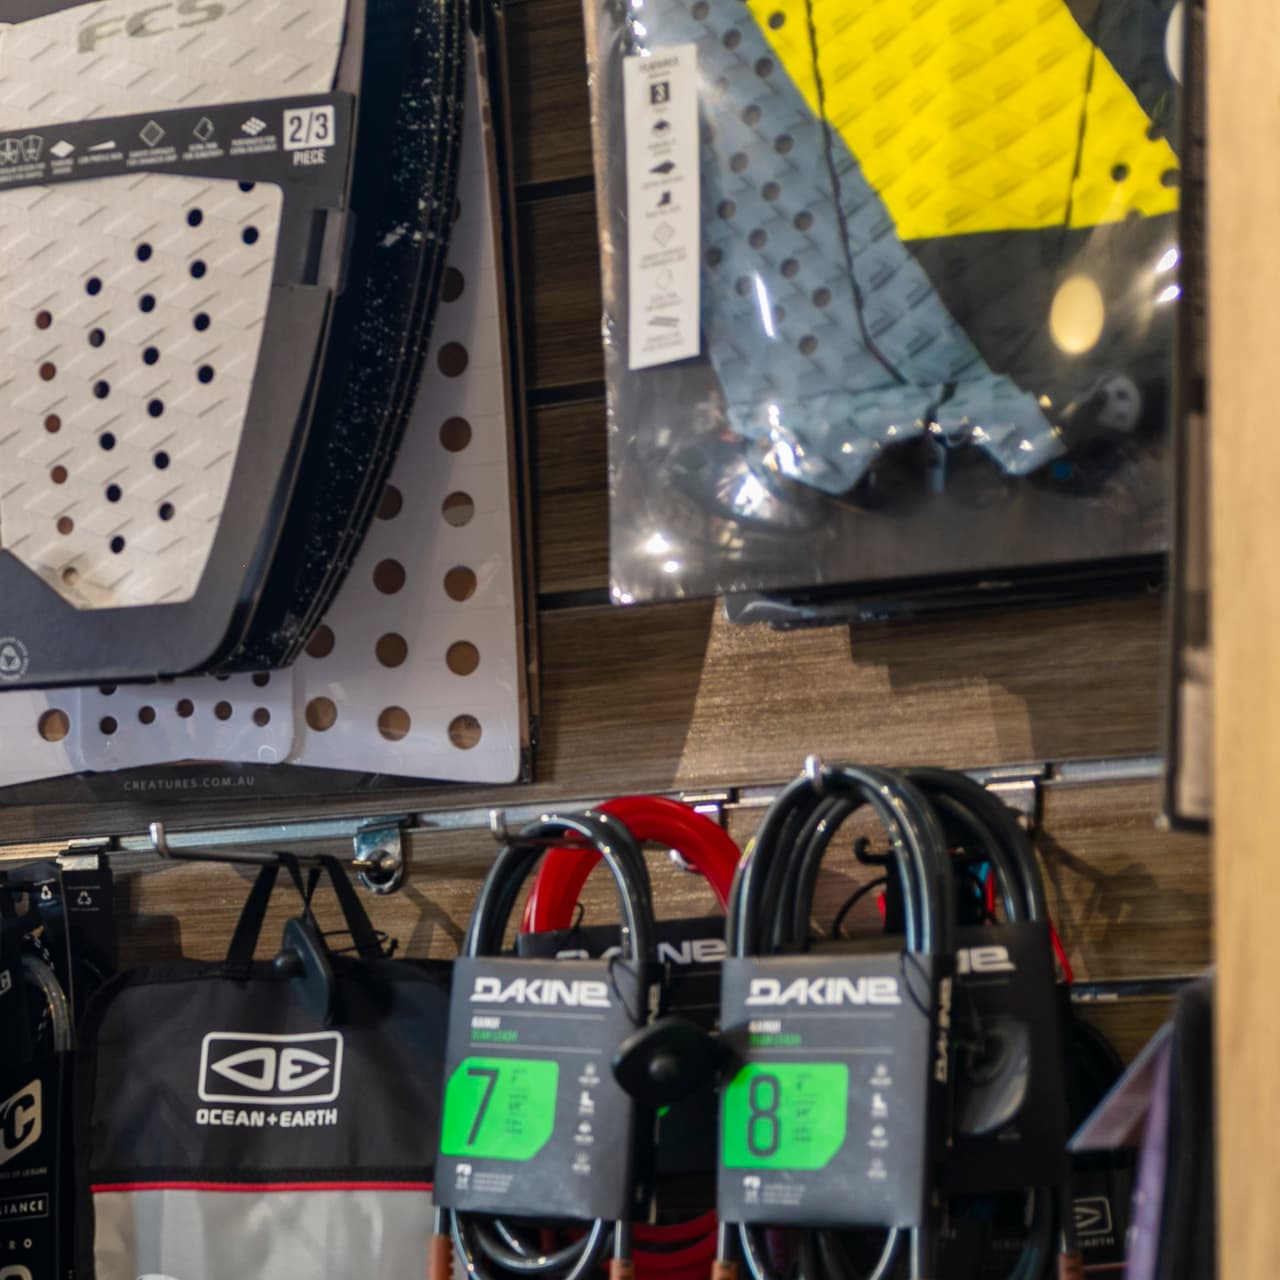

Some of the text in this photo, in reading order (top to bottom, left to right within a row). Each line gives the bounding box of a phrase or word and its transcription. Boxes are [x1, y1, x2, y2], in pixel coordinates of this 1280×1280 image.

[77, 0, 225, 54] FCS
[289, 111, 329, 144] 2/3
[293, 148, 326, 167] PIECE
[123, 774, 256, 791] CREATURES.COM.AU
[470, 977, 612, 1008] DAKINE
[745, 976, 903, 1006] DAKINE
[467, 1067, 500, 1146] 7
[747, 1074, 781, 1158] 8
